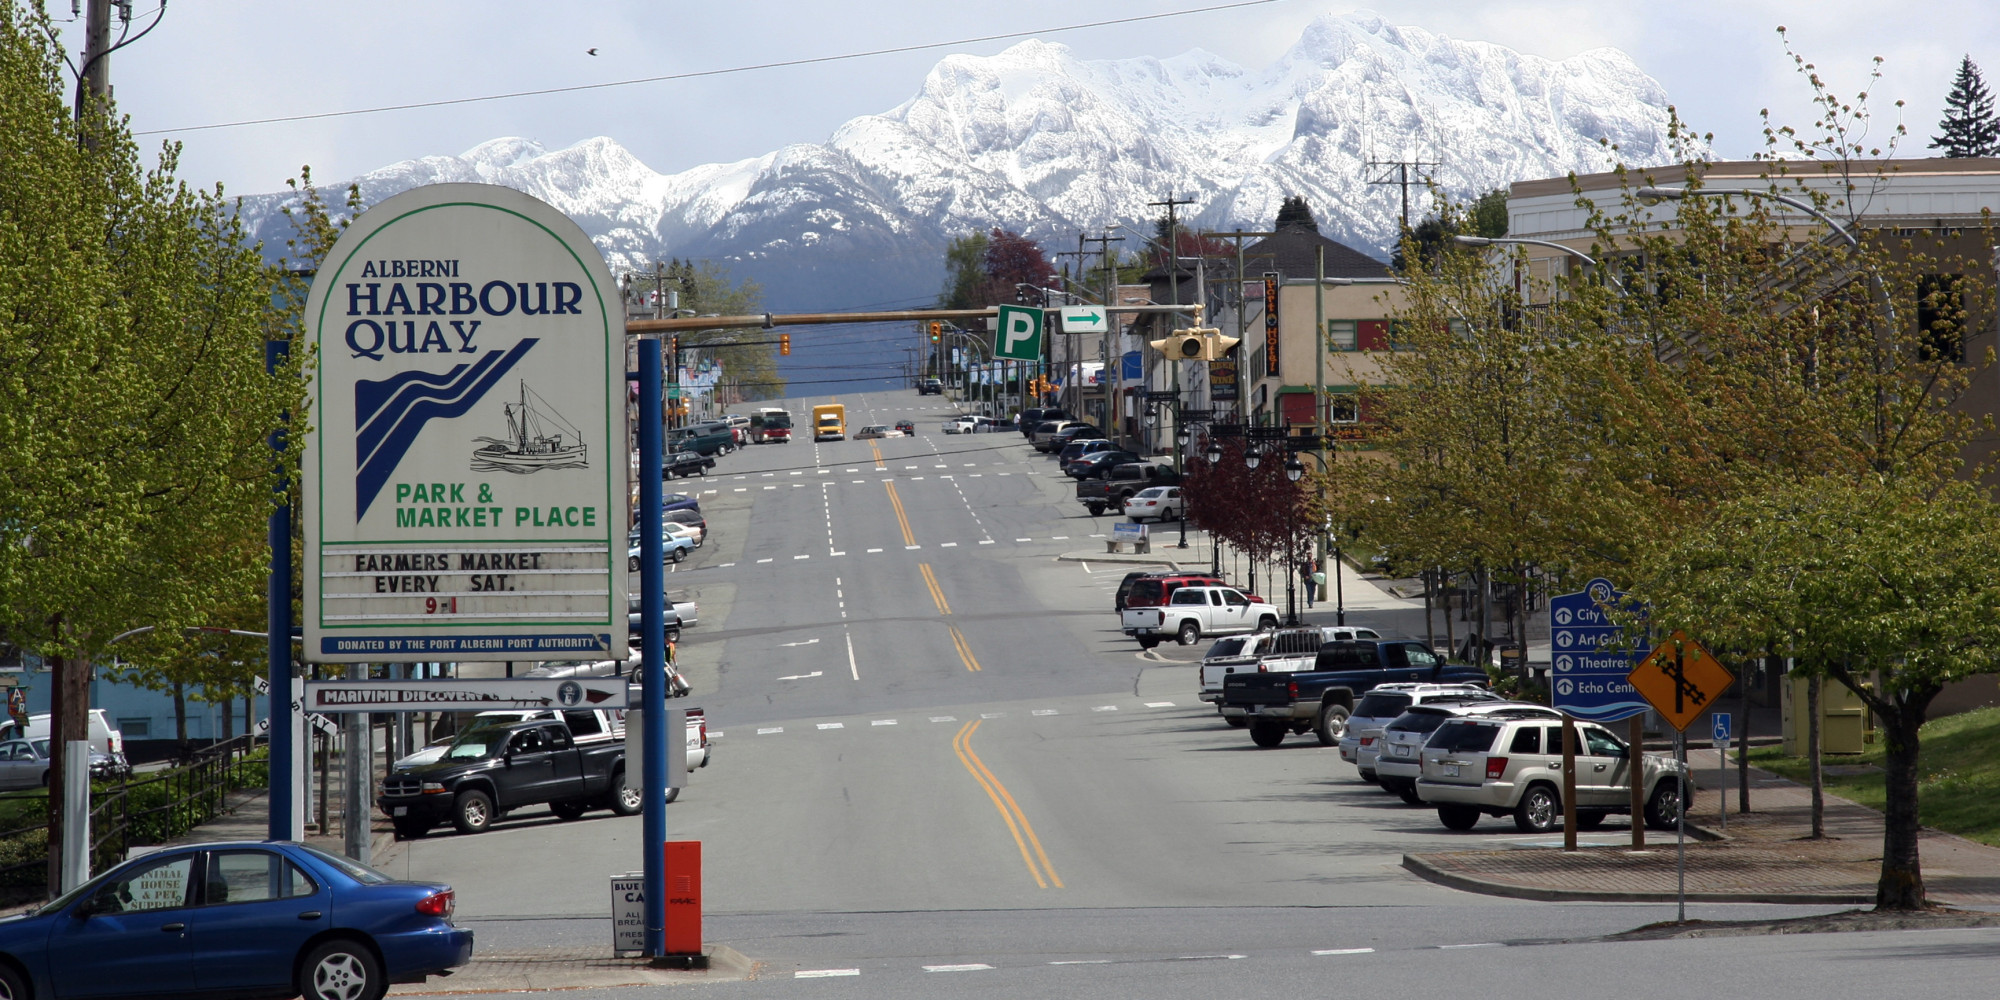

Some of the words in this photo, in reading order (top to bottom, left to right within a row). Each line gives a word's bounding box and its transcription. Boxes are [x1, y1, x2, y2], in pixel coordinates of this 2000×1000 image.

[361, 259, 459, 278] ALBERNI
[345, 280, 583, 316] HARBOUR
[345, 319, 481, 362] QUAY
[1004, 311, 1035, 354] P
[396, 483, 465, 503] PARK
[477, 483, 494, 503] &
[396, 507, 503, 527] MARKET
[515, 506, 596, 527] PLACE
[355, 554, 449, 572] FARMERS
[460, 553, 541, 570] MARKET
[375, 575, 439, 593] EVERY
[470, 574, 515, 592] SAT.
[1577, 608, 1600, 623] City
[338, 640, 385, 650] DONATED
[389, 640, 402, 650] BY
[406, 640, 425, 649] THE
[430, 640, 456, 649] PORT
[460, 639, 503, 649] ALBERNI
[507, 639, 534, 648] PORT
[538, 638, 594, 648] AUTHORITY
[1578, 634, 1596, 645] Art
[1600, 633, 1641, 648] Gallry
[1578, 656, 1631, 669] Theatres
[324, 690, 399, 703] MARIIM
[1578, 682, 1604, 693] Echo
[1607, 681, 1635, 693] Cent
[141, 880, 180, 889] HOUSE
